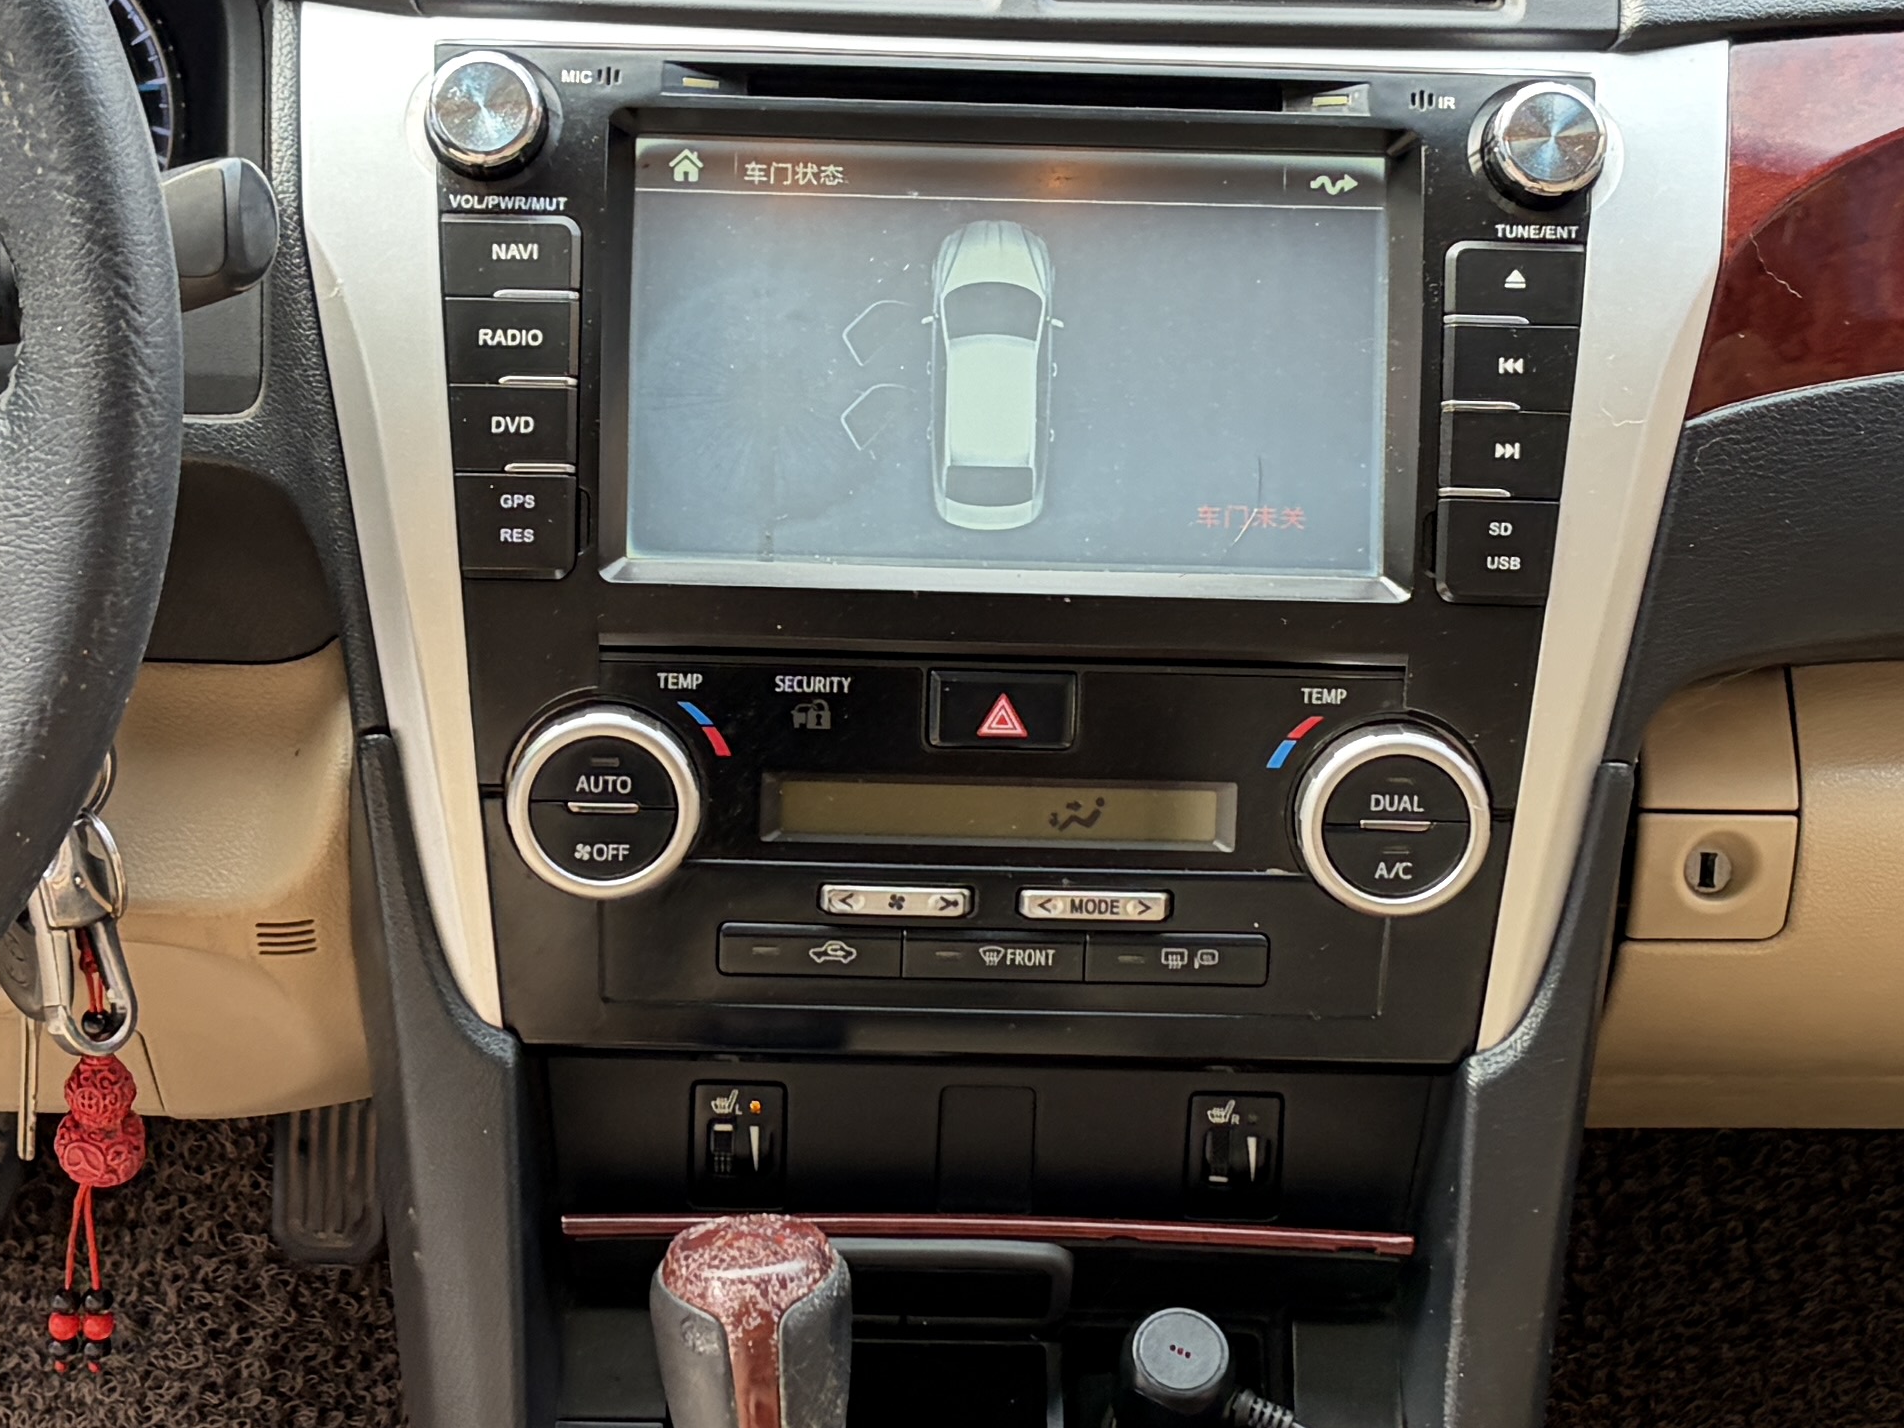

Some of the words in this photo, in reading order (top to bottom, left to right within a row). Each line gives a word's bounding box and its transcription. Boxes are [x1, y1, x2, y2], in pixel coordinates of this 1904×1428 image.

[560, 69, 593, 84] MIC
[1437, 95, 1456, 110] IR
[743, 160, 844, 186] 车门状态
[448, 193, 568, 211] VOL/PWR/MUT
[1494, 224, 1580, 240] TUNE/ENT
[491, 243, 539, 261] NAVI
[478, 328, 544, 347] RADIO
[490, 415, 535, 434] DVD
[499, 494, 536, 509] GPS
[499, 528, 535, 543] RES
[1488, 522, 1513, 536] SD
[1486, 556, 1521, 571] USB
[656, 672, 703, 691] TEMP
[774, 675, 852, 694] SECURITY
[1301, 688, 1348, 706] TEMP
[576, 775, 632, 795] AUTO
[1369, 794, 1425, 813] DUAL
[592, 844, 631, 862] OFF
[1374, 861, 1413, 880] A/C
[1069, 898, 1121, 916] MODE
[1005, 949, 1056, 967] FRONT
